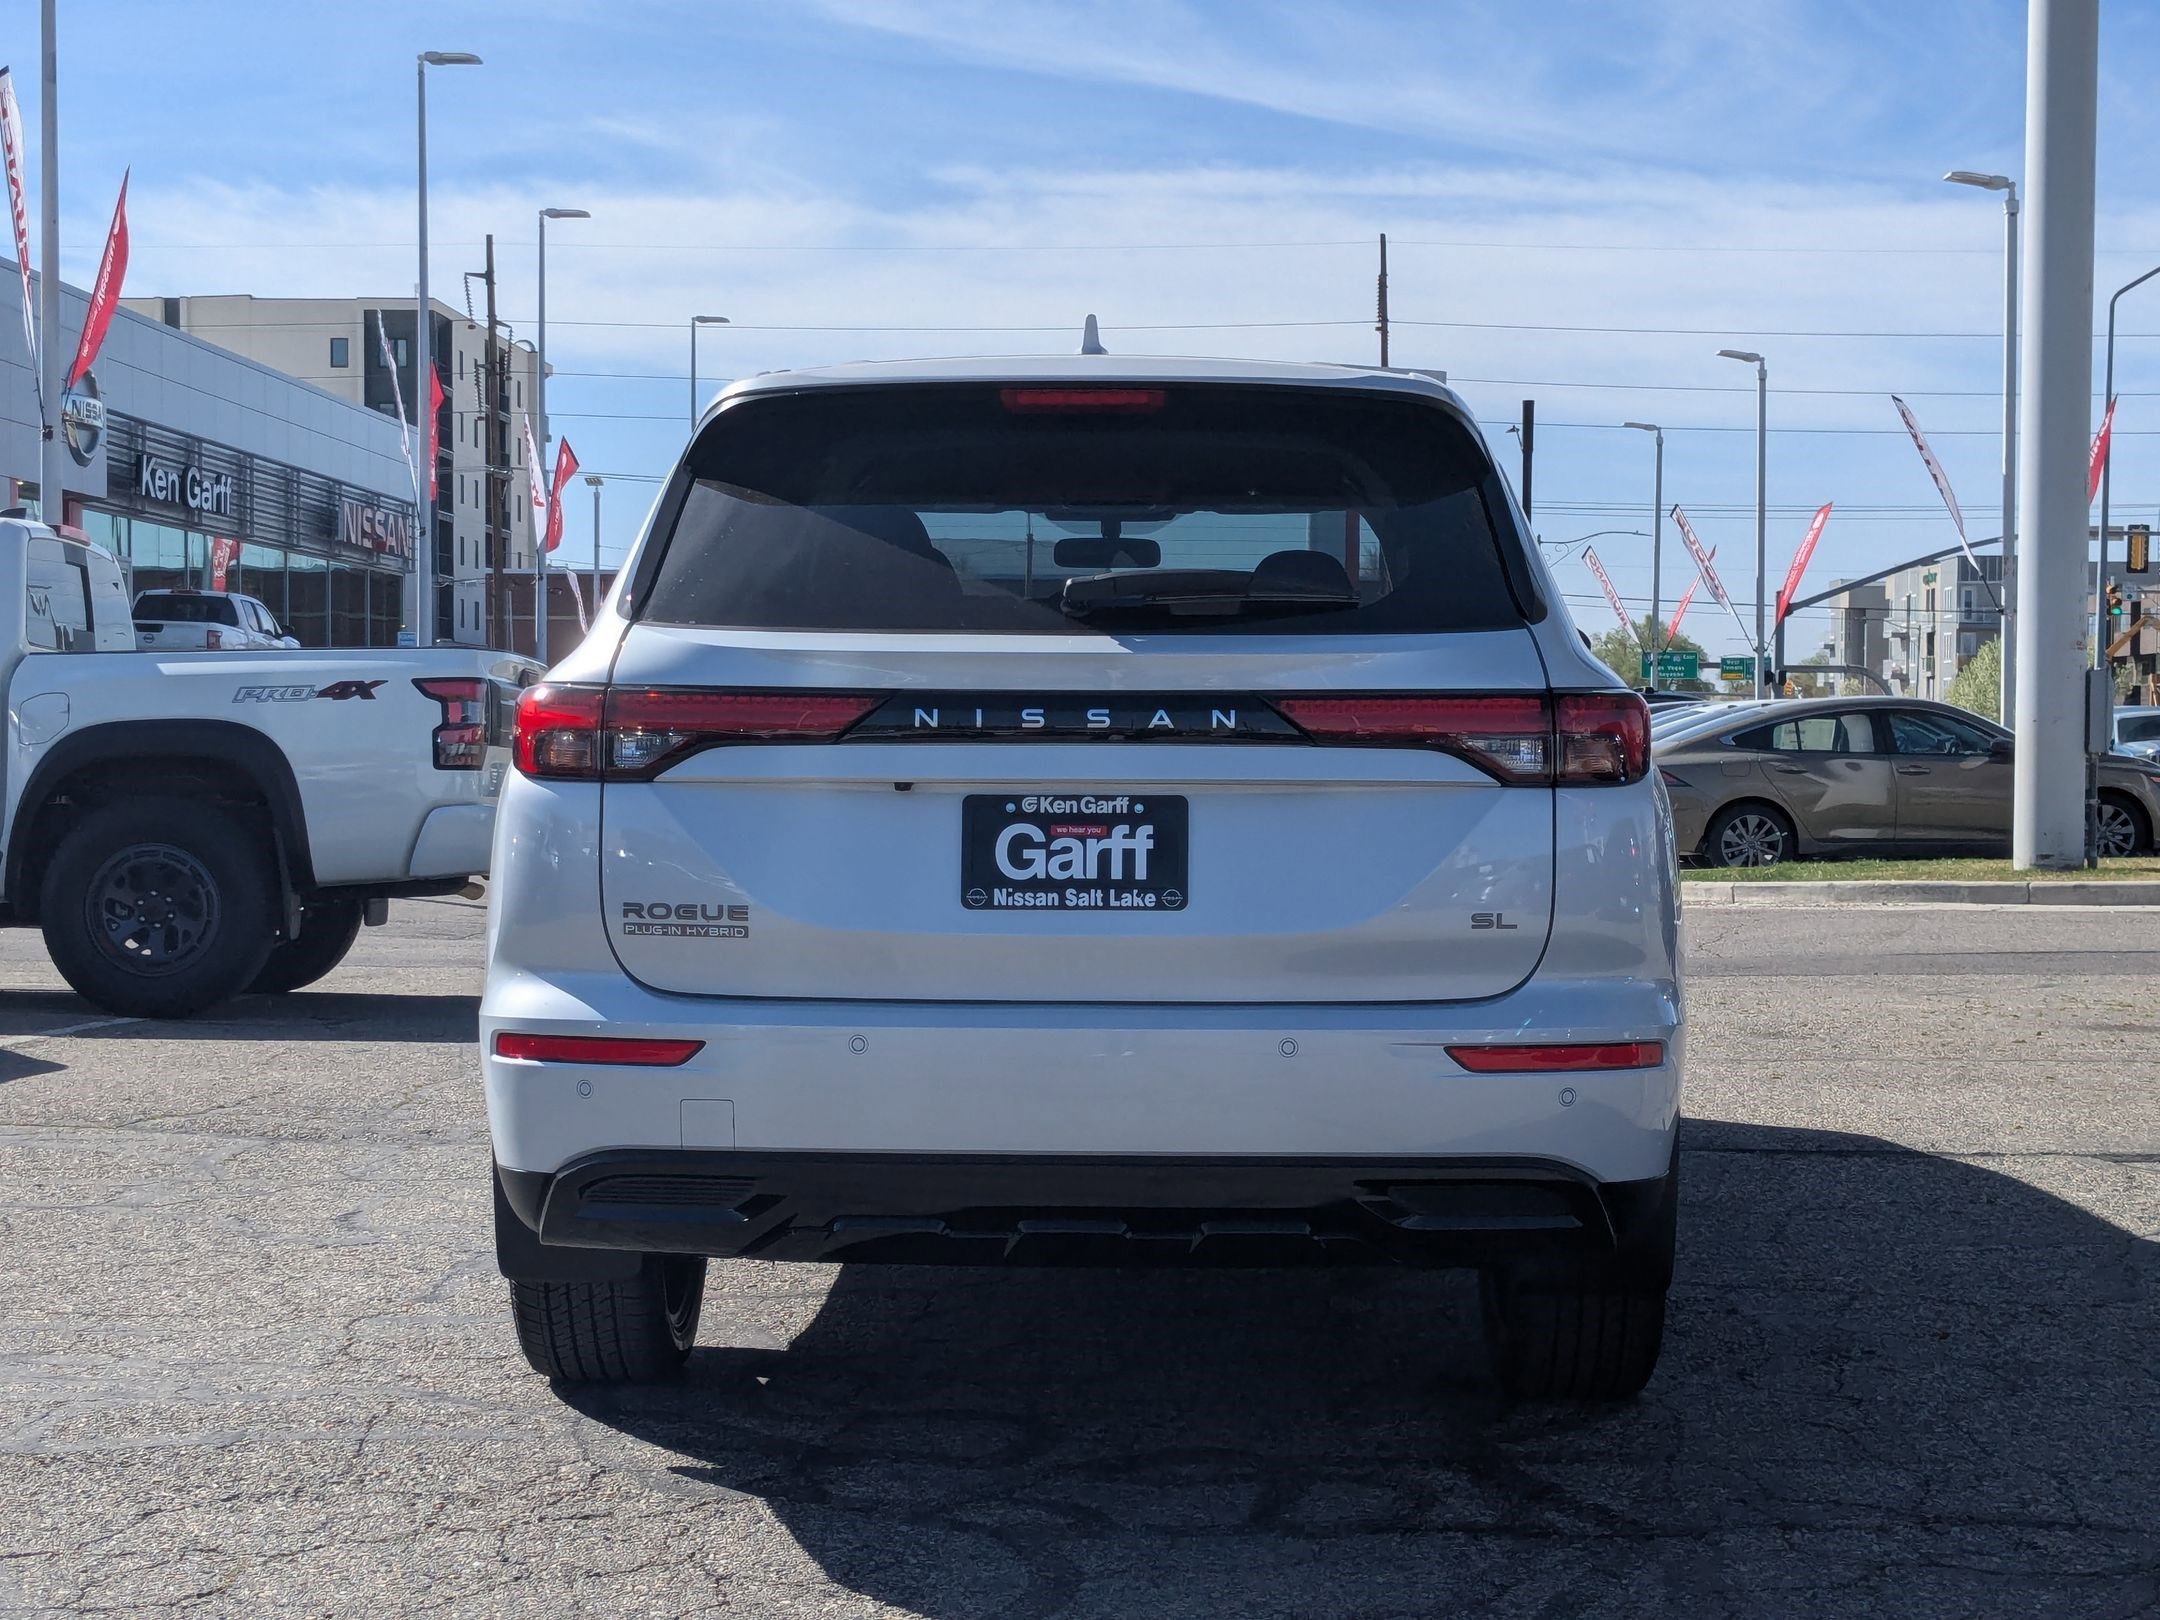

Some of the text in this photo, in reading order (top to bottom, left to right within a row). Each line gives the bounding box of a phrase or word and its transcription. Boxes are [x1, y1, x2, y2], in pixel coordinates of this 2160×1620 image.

[141, 454, 232, 515] Ken Garff
[344, 501, 409, 557] NISSAN
[914, 708, 1236, 729] NISSAN
[1040, 796, 1130, 814] Ken Garff
[1069, 826, 1086, 834] hear
[1087, 827, 1101, 835] you
[995, 823, 1154, 880] Garff
[993, 888, 1157, 907] Nissan Salt Lake
[623, 902, 749, 922] ROGUE
[1471, 912, 1518, 929] SL
[625, 924, 746, 938] PLUG-IN HYBRID
